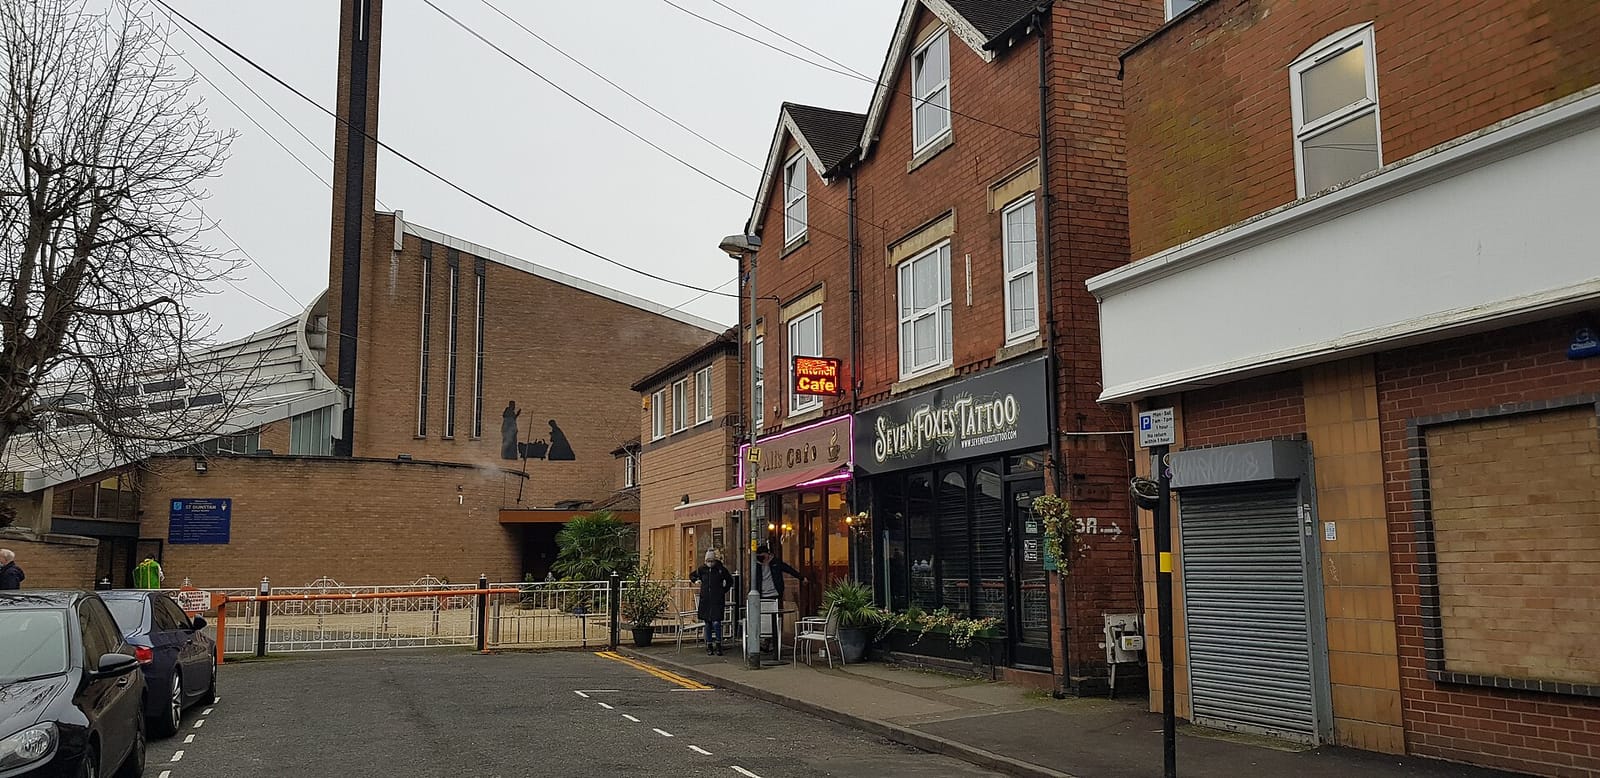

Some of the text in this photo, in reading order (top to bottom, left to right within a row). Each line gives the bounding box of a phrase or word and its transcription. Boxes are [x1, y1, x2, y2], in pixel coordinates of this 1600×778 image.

[799, 377, 835, 391] Cafe
[874, 394, 1017, 463] SEVEN FOXES TATTOO
[1142, 417, 1150, 429] P
[748, 448, 760, 461] H
